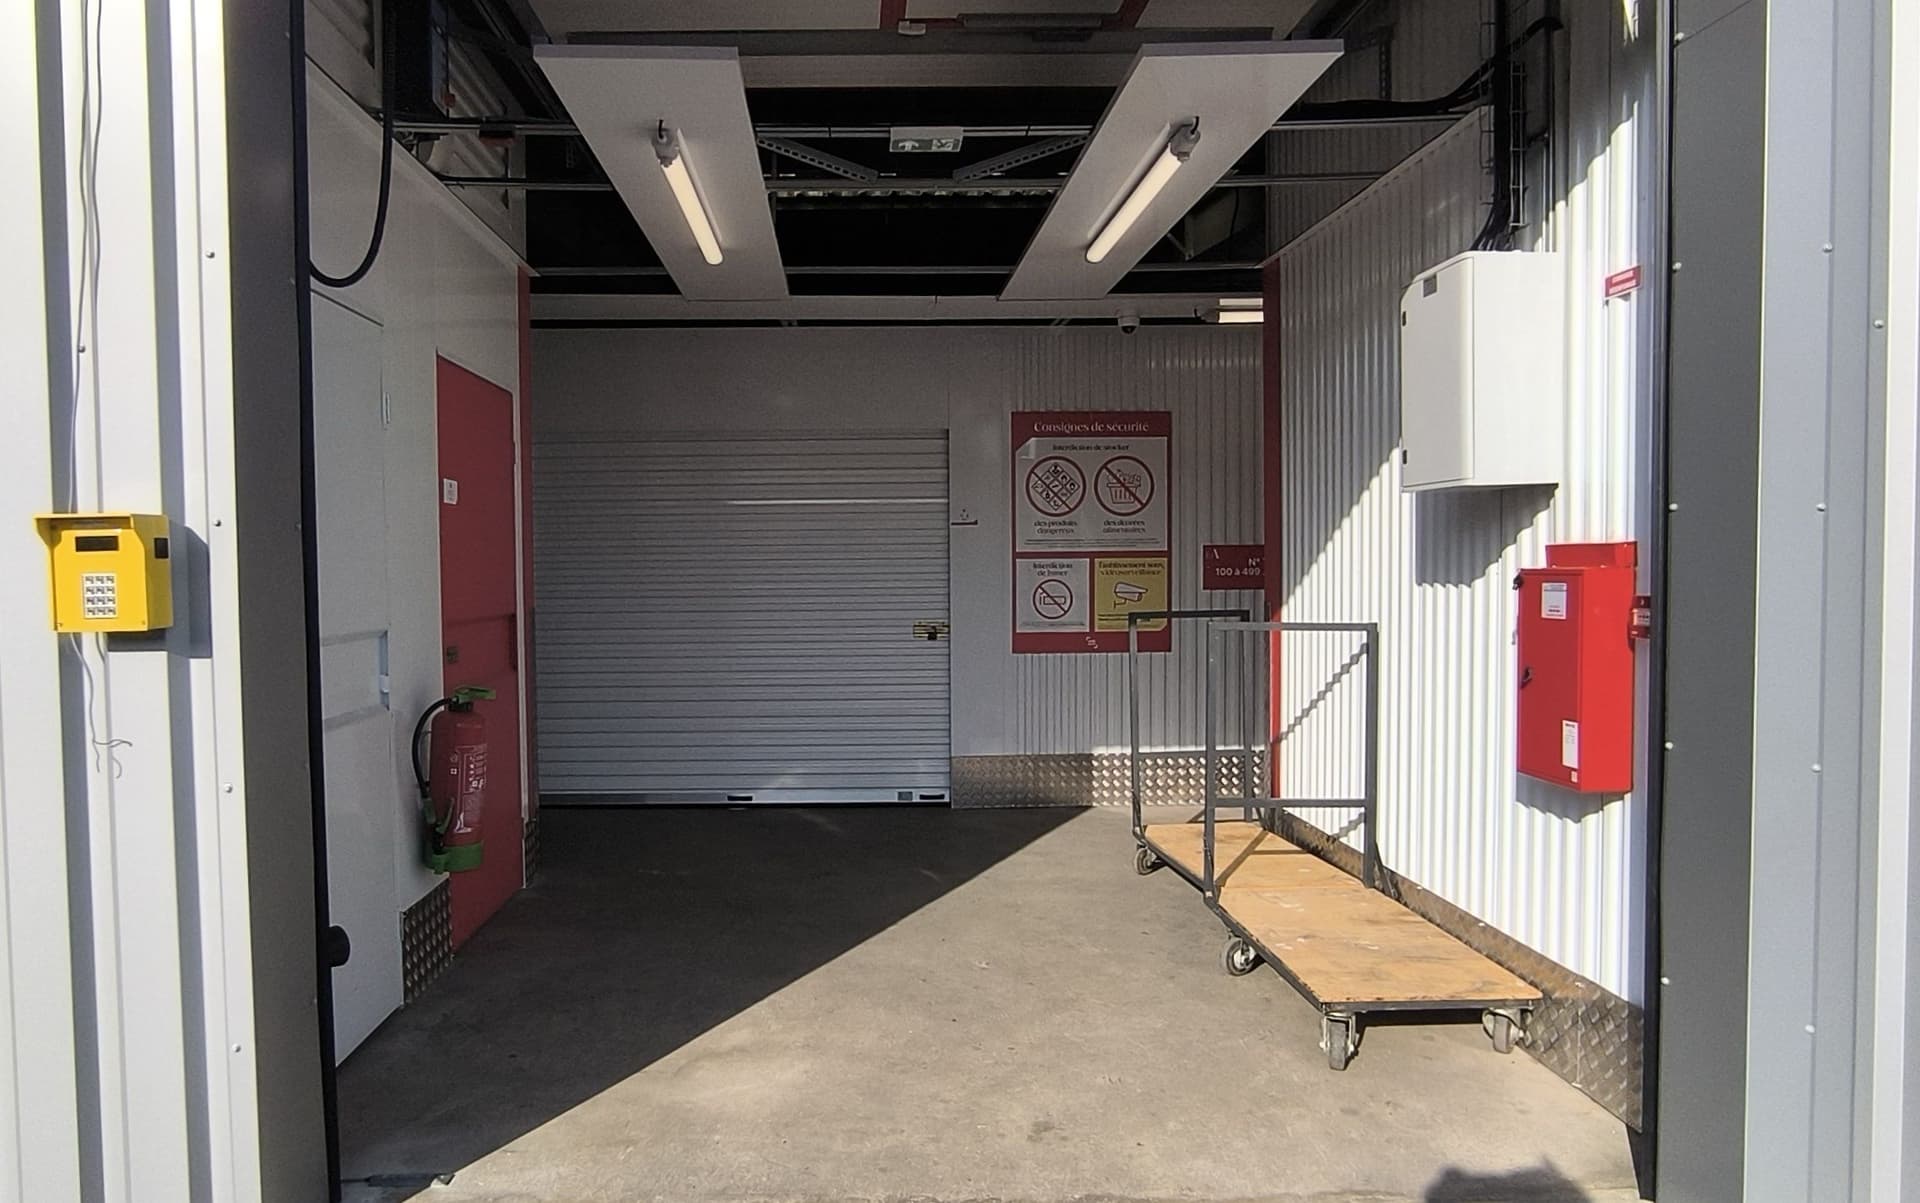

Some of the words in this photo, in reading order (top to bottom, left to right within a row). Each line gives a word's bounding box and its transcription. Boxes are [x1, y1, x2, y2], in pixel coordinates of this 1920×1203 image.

[1034, 421, 1088, 434] Consignes
[1091, 421, 1105, 432] de
[1215, 567, 1233, 576] 100
